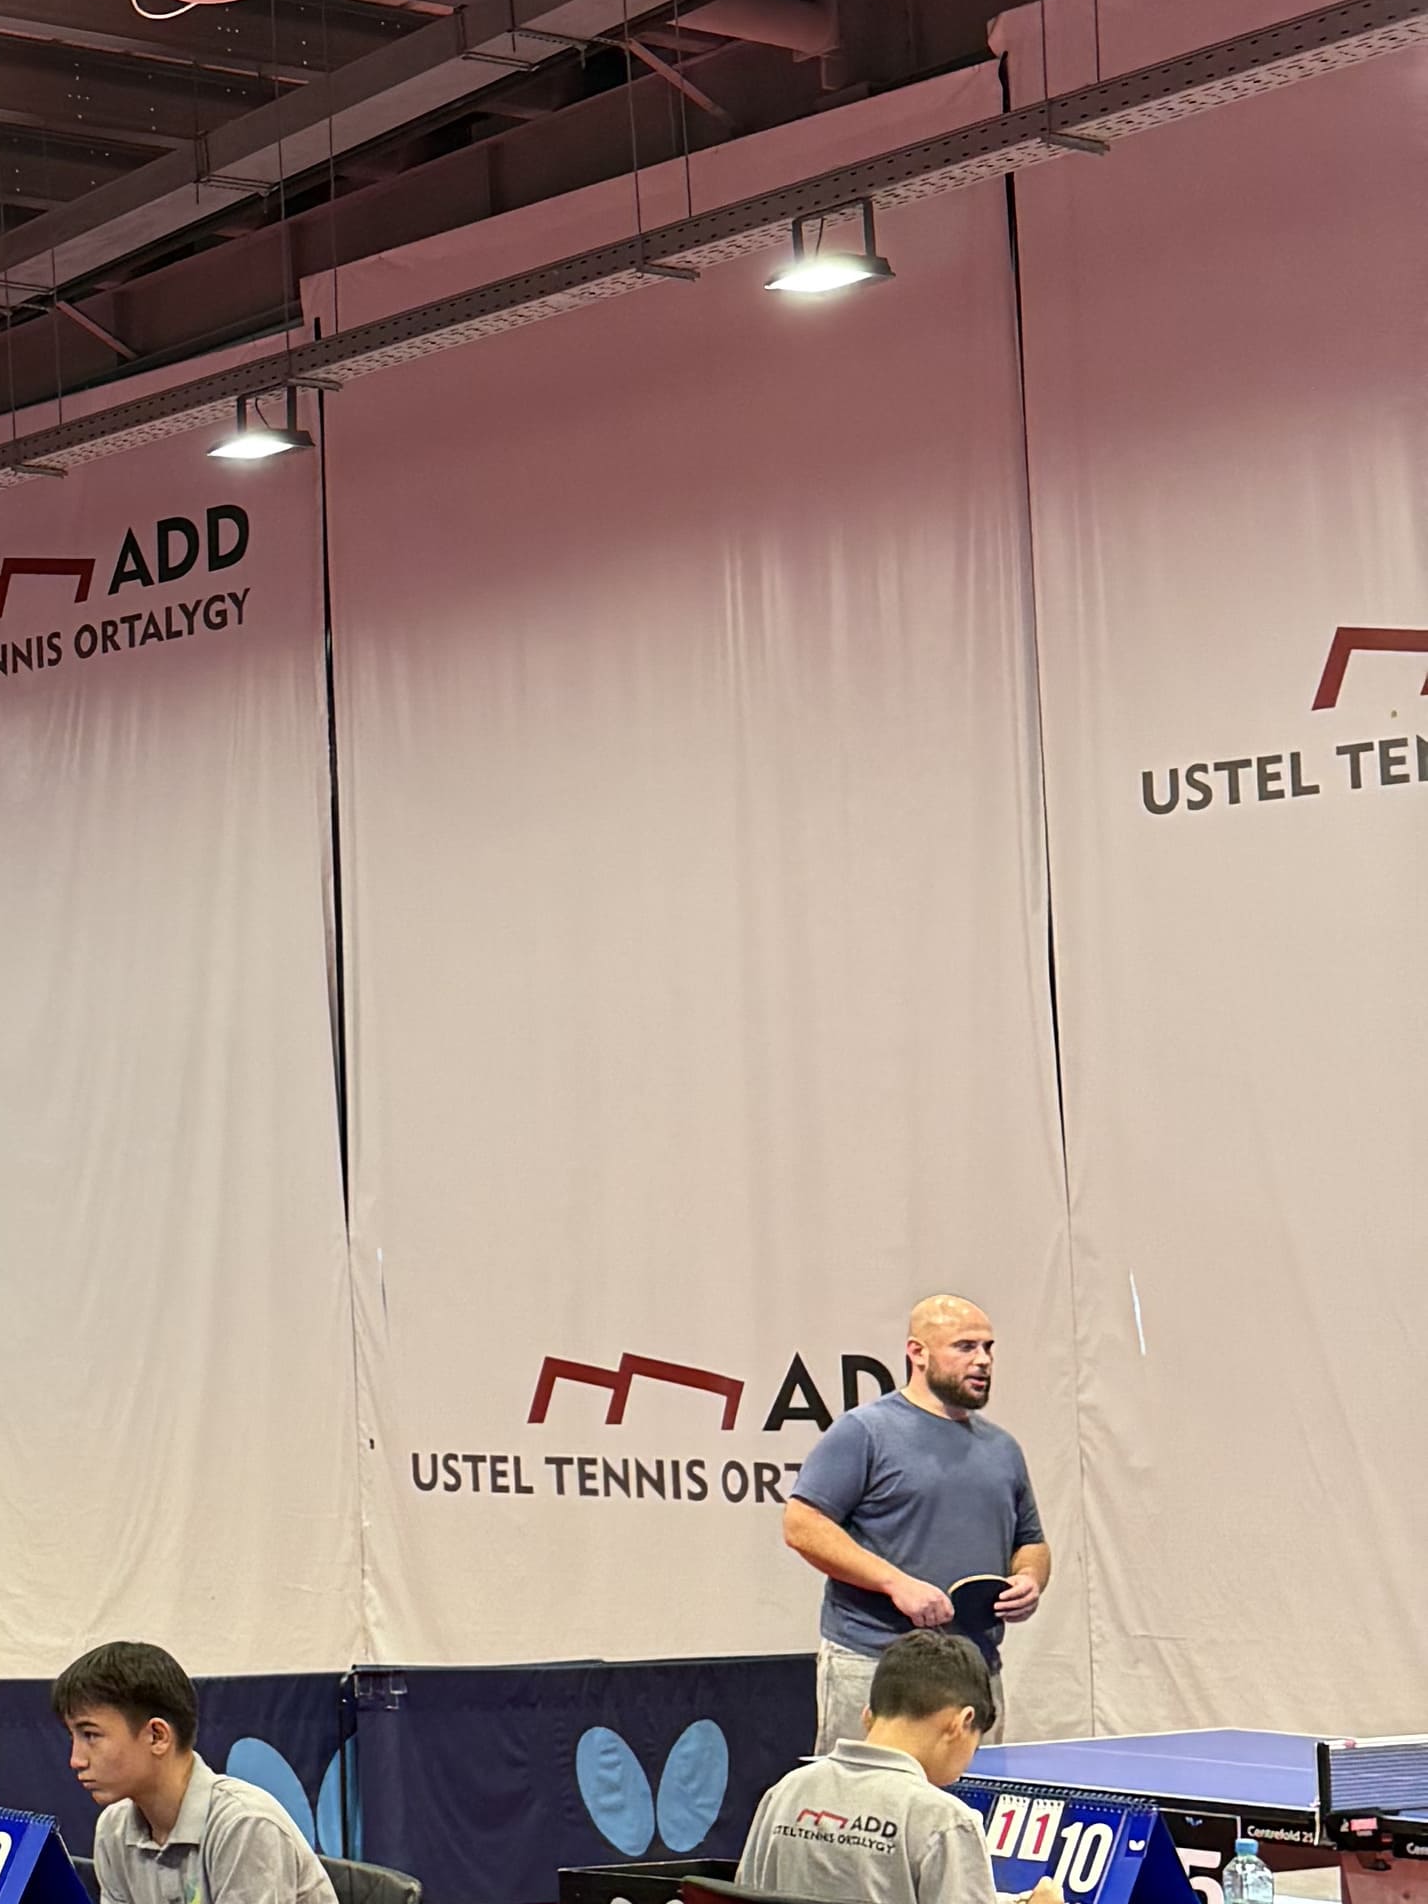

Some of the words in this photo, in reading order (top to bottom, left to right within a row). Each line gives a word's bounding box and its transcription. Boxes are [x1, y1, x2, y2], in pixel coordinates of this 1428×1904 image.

[107, 504, 250, 596] ADD
[73, 588, 251, 659] ORTALYGY
[1142, 751, 1320, 815] USTEL
[762, 1352, 910, 1431] AD
[411, 1452, 534, 1495] USTEL
[544, 1456, 709, 1502] TENNIS
[850, 1815, 898, 1838] ADD
[995, 1809, 1017, 1851] 1
[1032, 1813, 1051, 1855] 1
[1053, 1822, 1114, 1894] 10
